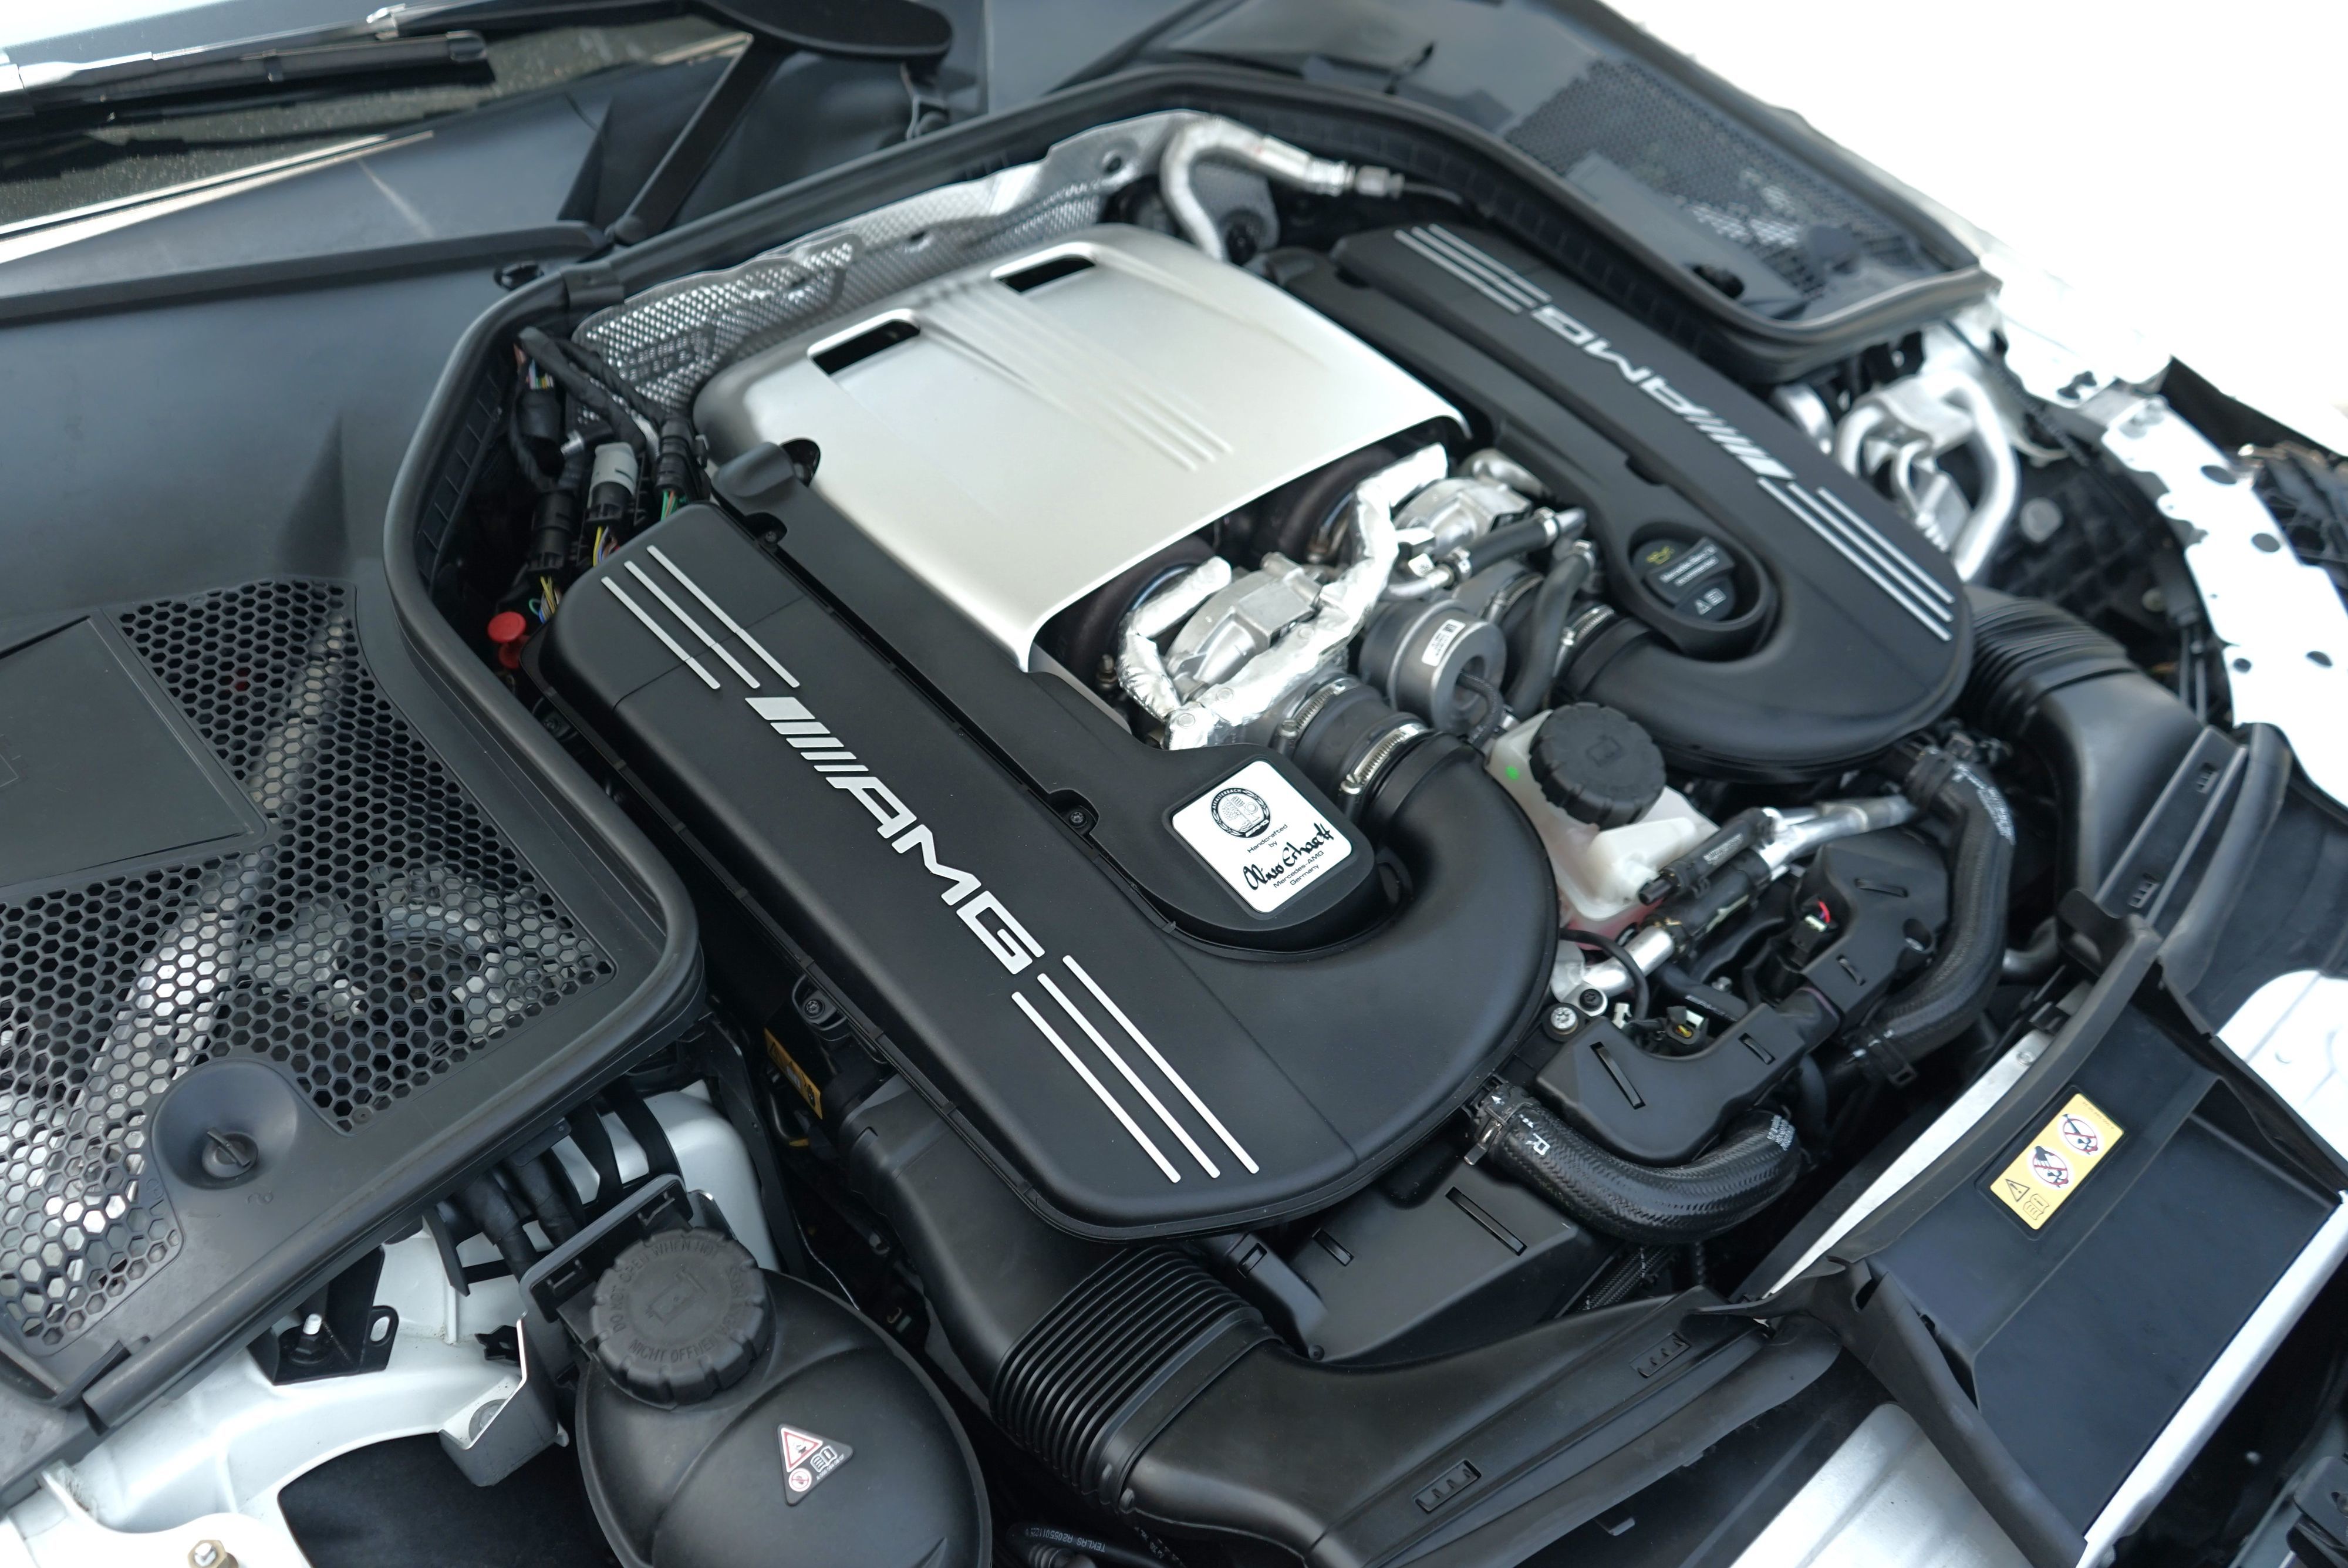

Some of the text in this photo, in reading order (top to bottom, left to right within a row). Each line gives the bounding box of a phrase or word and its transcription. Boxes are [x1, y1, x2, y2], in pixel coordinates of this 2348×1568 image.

[1247, 824, 1288, 854] Handcrafted
[825, 777, 1045, 974] AMG
[1273, 850, 1324, 888] Mercedes-AMG
[1290, 864, 1320, 886] Germany
[651, 1239, 691, 1256] WHEN
[629, 1339, 665, 1362] NICHT
[1076, 1537, 1106, 1553] TEKLAS
